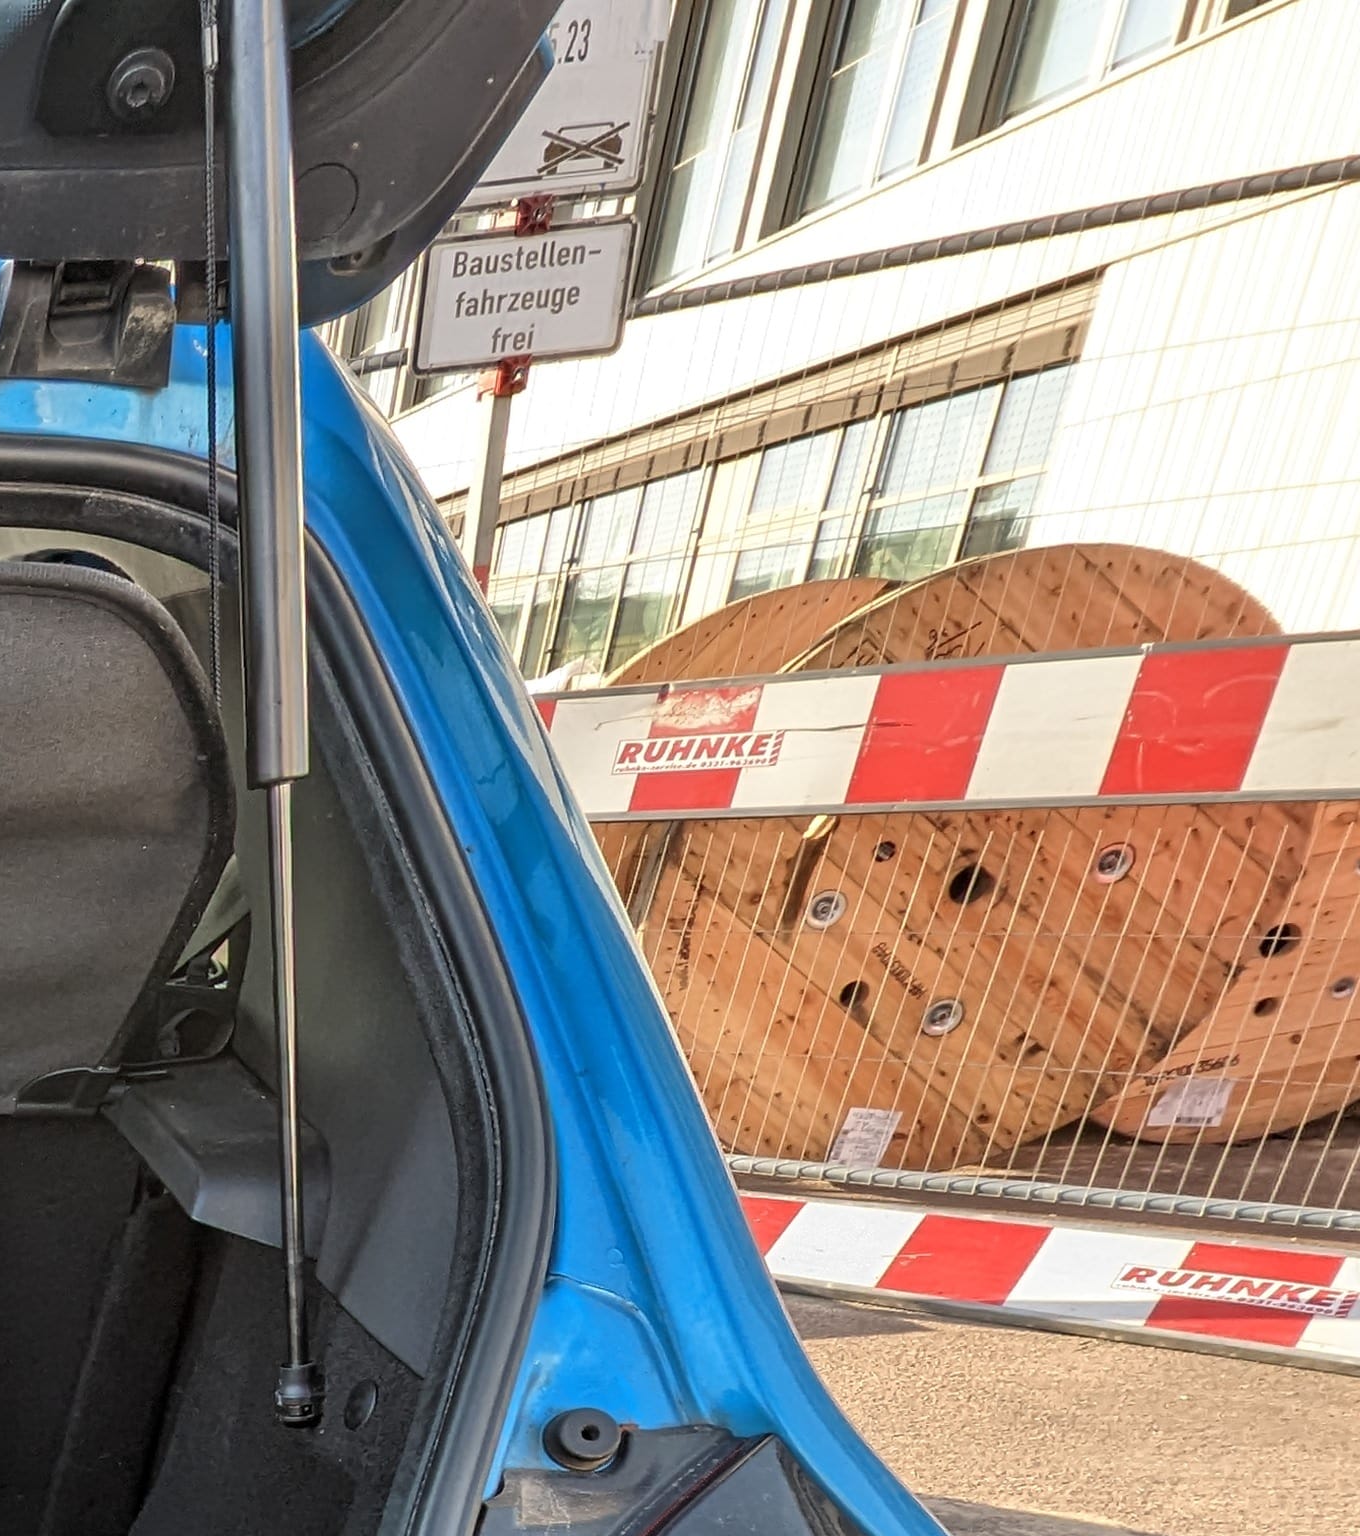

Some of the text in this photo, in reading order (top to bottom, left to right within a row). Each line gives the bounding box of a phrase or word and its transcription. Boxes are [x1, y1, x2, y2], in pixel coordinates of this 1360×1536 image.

[452, 240, 602, 278] Baustellen-
[455, 285, 580, 318] fahrzeuge
[491, 324, 535, 354] frei
[617, 732, 774, 765] RUHNKE
[1120, 1266, 1342, 1308] RUHNKE
